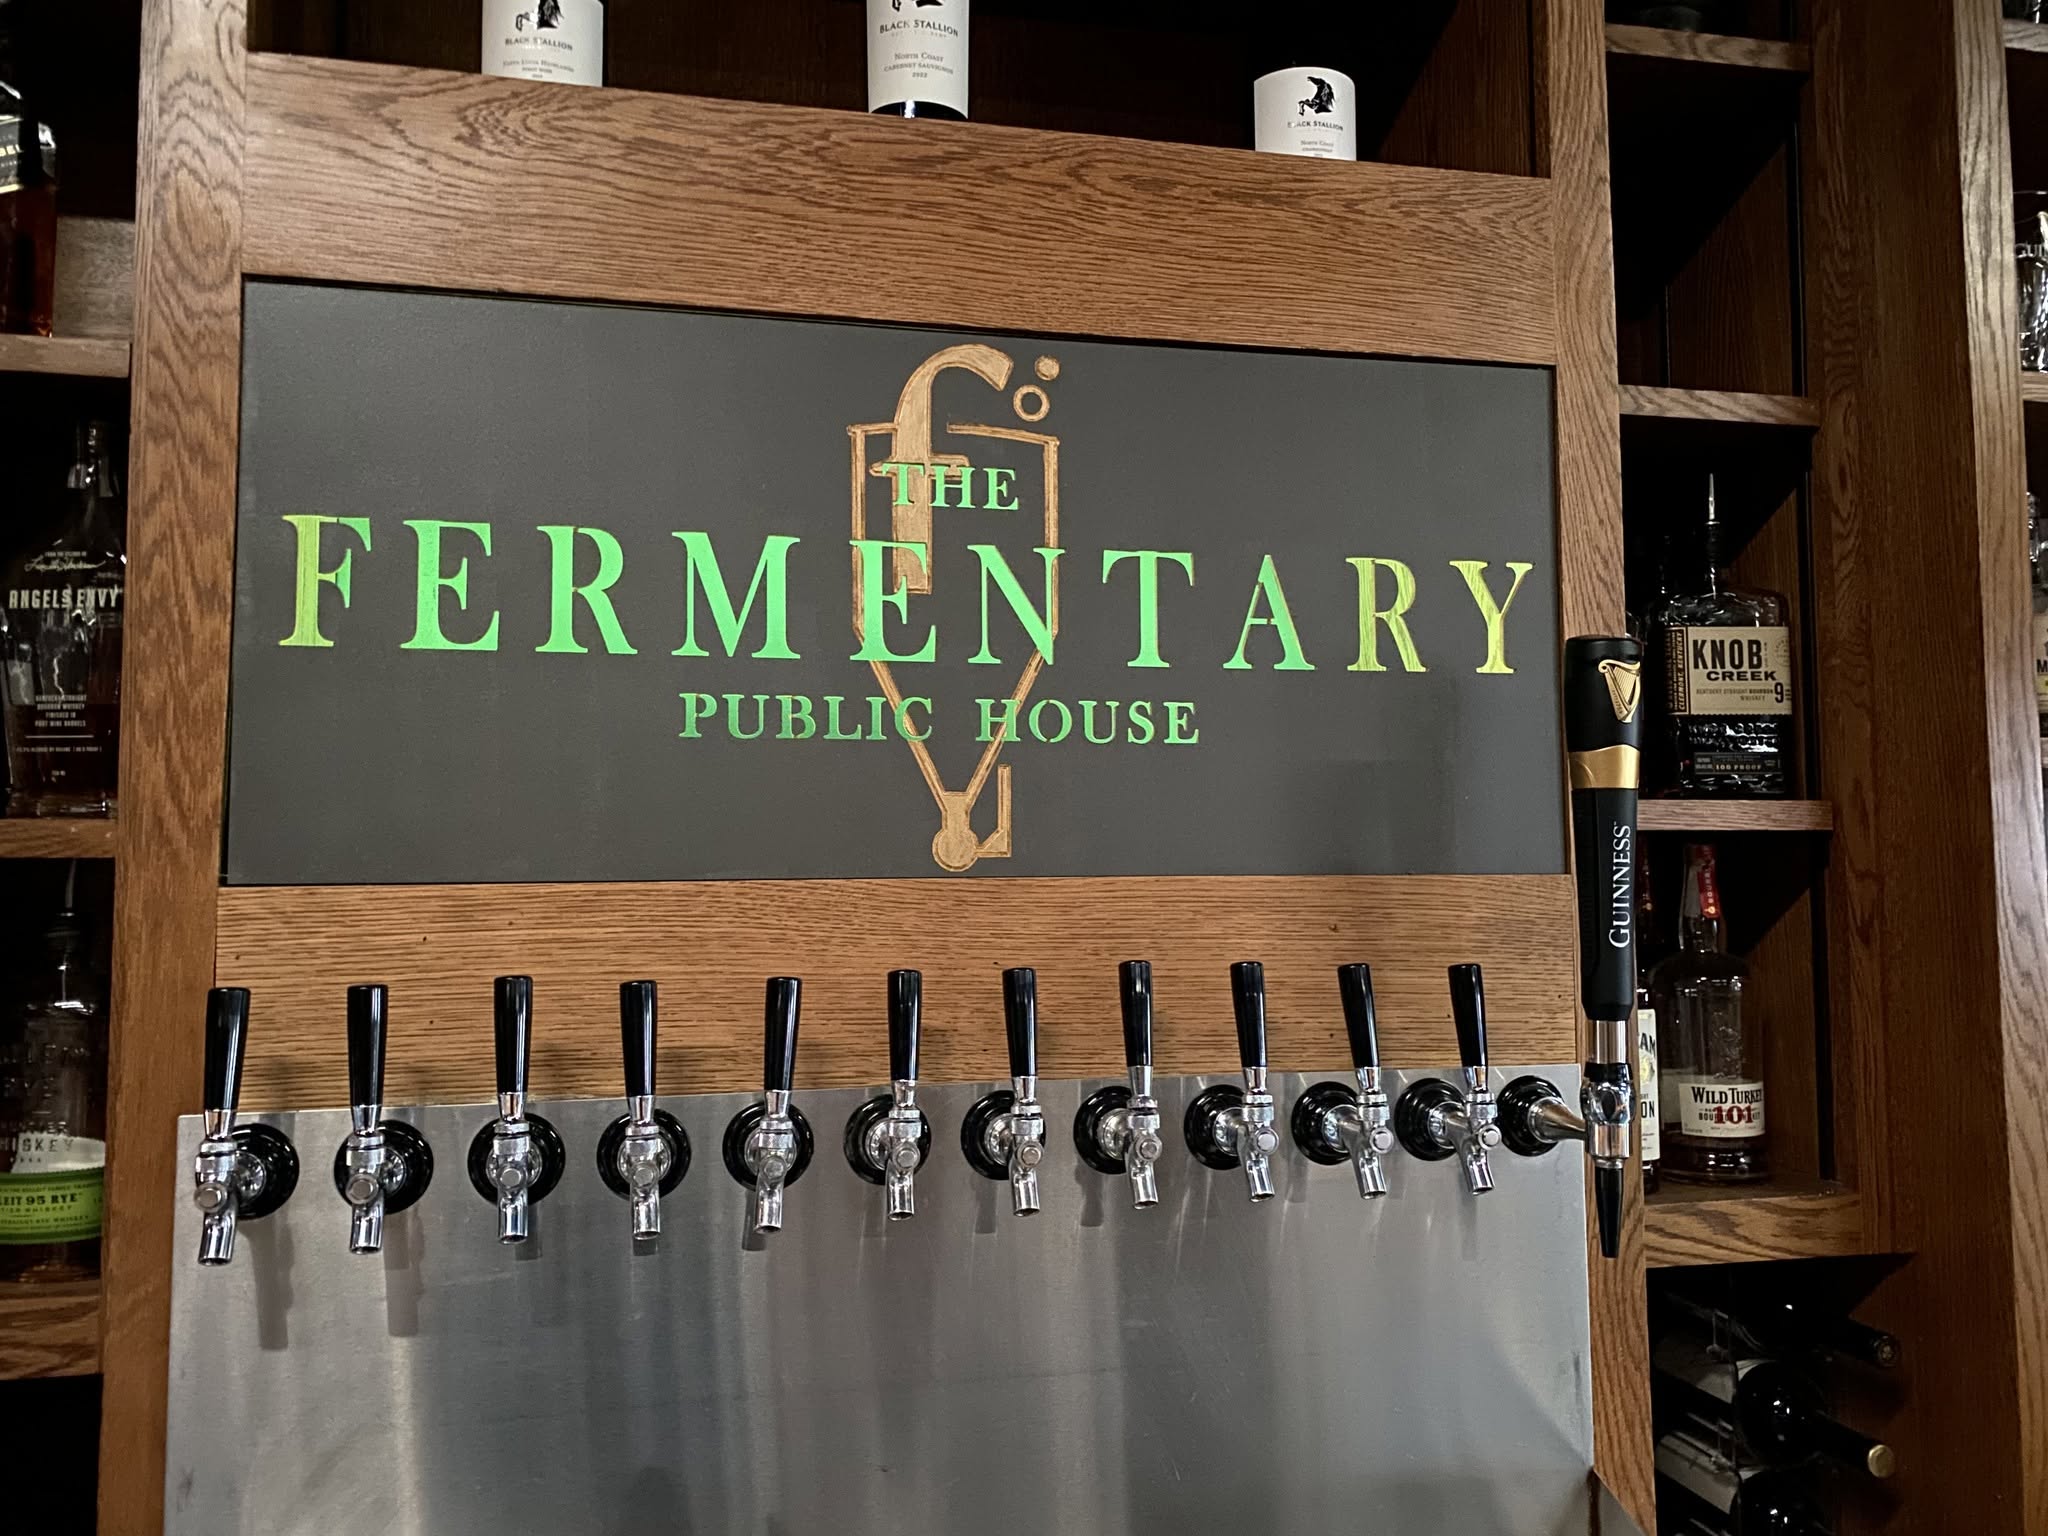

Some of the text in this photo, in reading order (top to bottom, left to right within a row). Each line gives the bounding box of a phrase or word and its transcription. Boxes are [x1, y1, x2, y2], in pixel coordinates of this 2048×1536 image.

[879, 20, 910, 34] BLACK
[913, 20, 959, 37] STALLION
[1313, 120, 1344, 131] STALLION
[882, 462, 1019, 511] THE
[77, 586, 119, 608] ENVY
[278, 514, 1533, 675] FERMENTARY
[1692, 639, 1762, 670] KNOB
[1706, 671, 1777, 681] CREEK
[1774, 682, 1784, 703] 9
[679, 693, 1200, 745] PUBLIC HOUSE
[1608, 825, 1631, 948] GUINNESS
[1691, 1086, 1728, 1104] WILD
[1712, 1105, 1754, 1125] 101
[26, 1195, 46, 1205] 95
[51, 1192, 78, 1204] RYE
